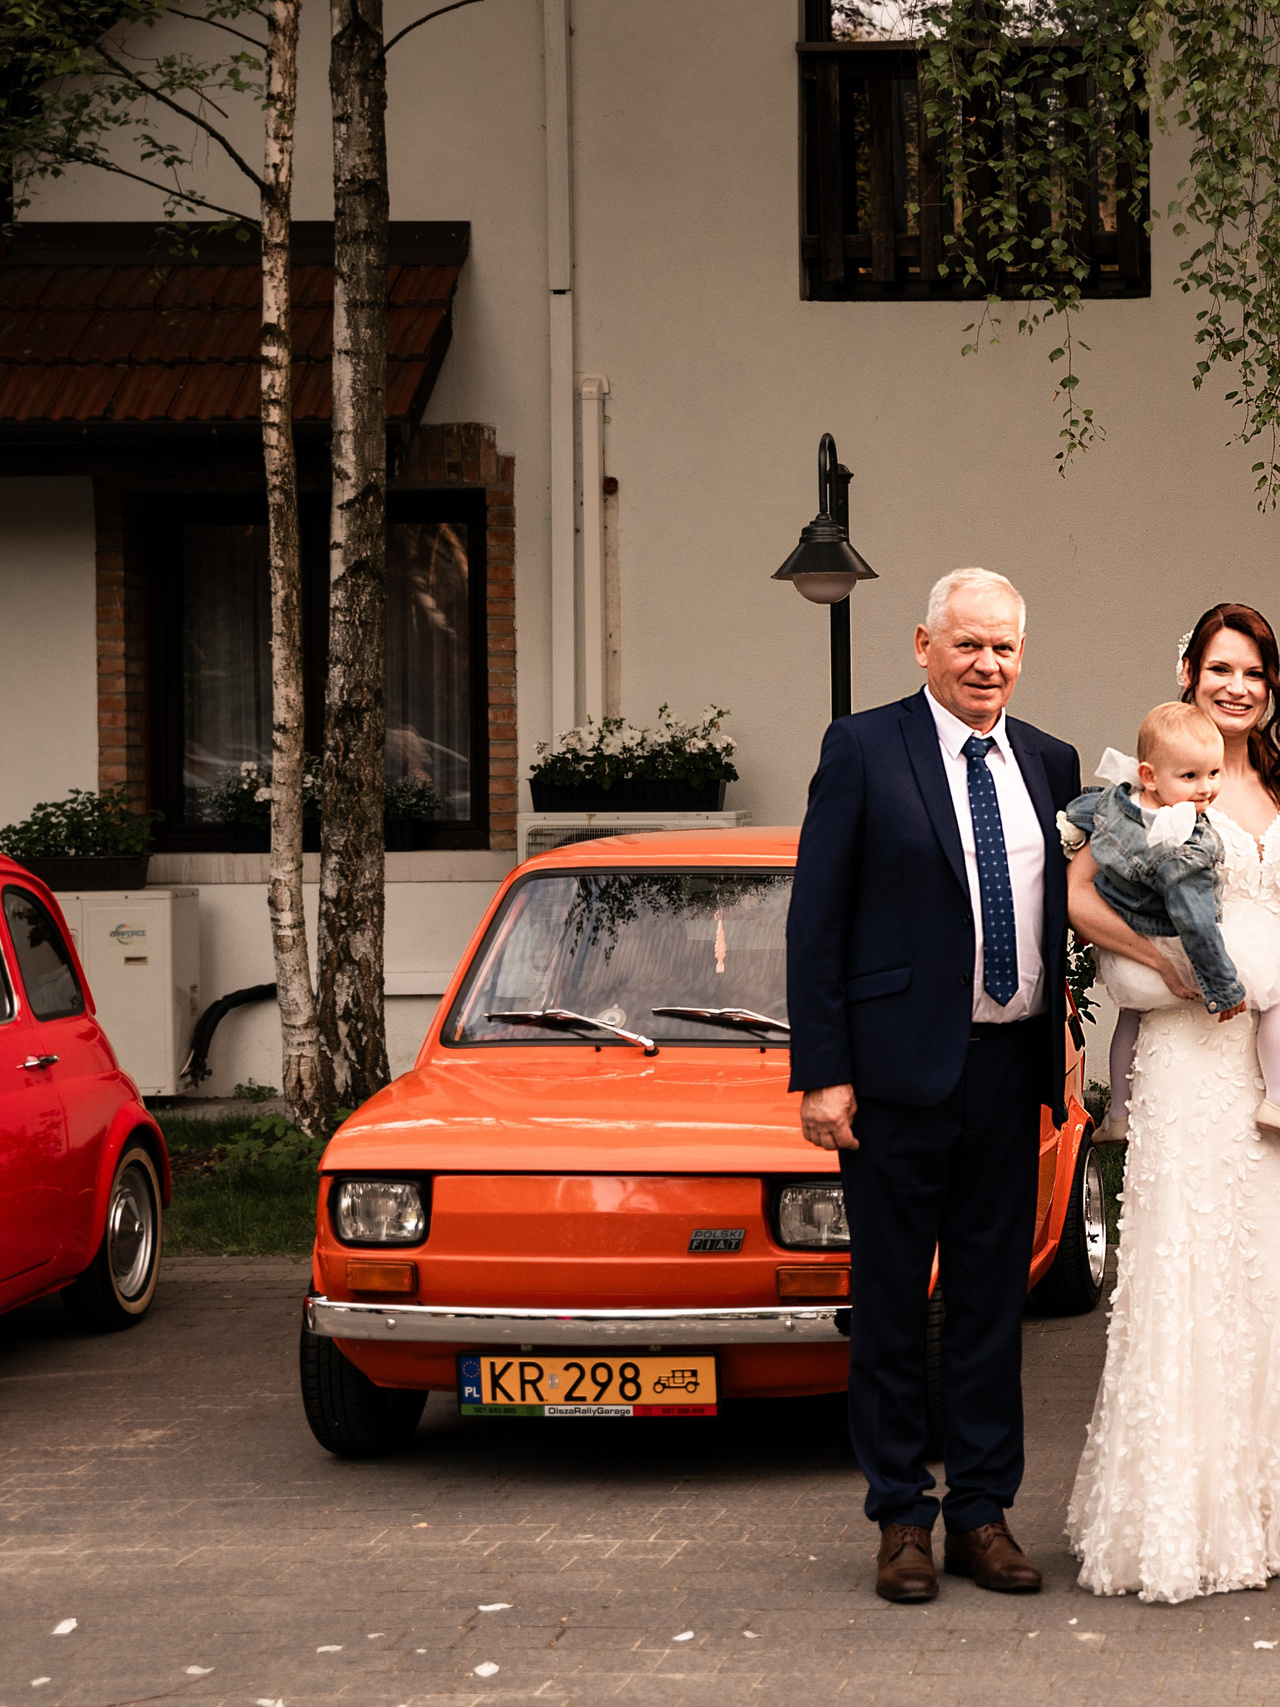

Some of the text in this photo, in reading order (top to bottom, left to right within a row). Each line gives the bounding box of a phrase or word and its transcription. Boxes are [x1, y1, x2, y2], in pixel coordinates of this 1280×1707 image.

[694, 1230, 742, 1238] POLSKI
[692, 1240, 738, 1249] FIAT
[489, 1361, 642, 1402] KR 298
[464, 1387, 480, 1398] PL
[548, 1407, 631, 1416] OlszaRallyGarage
